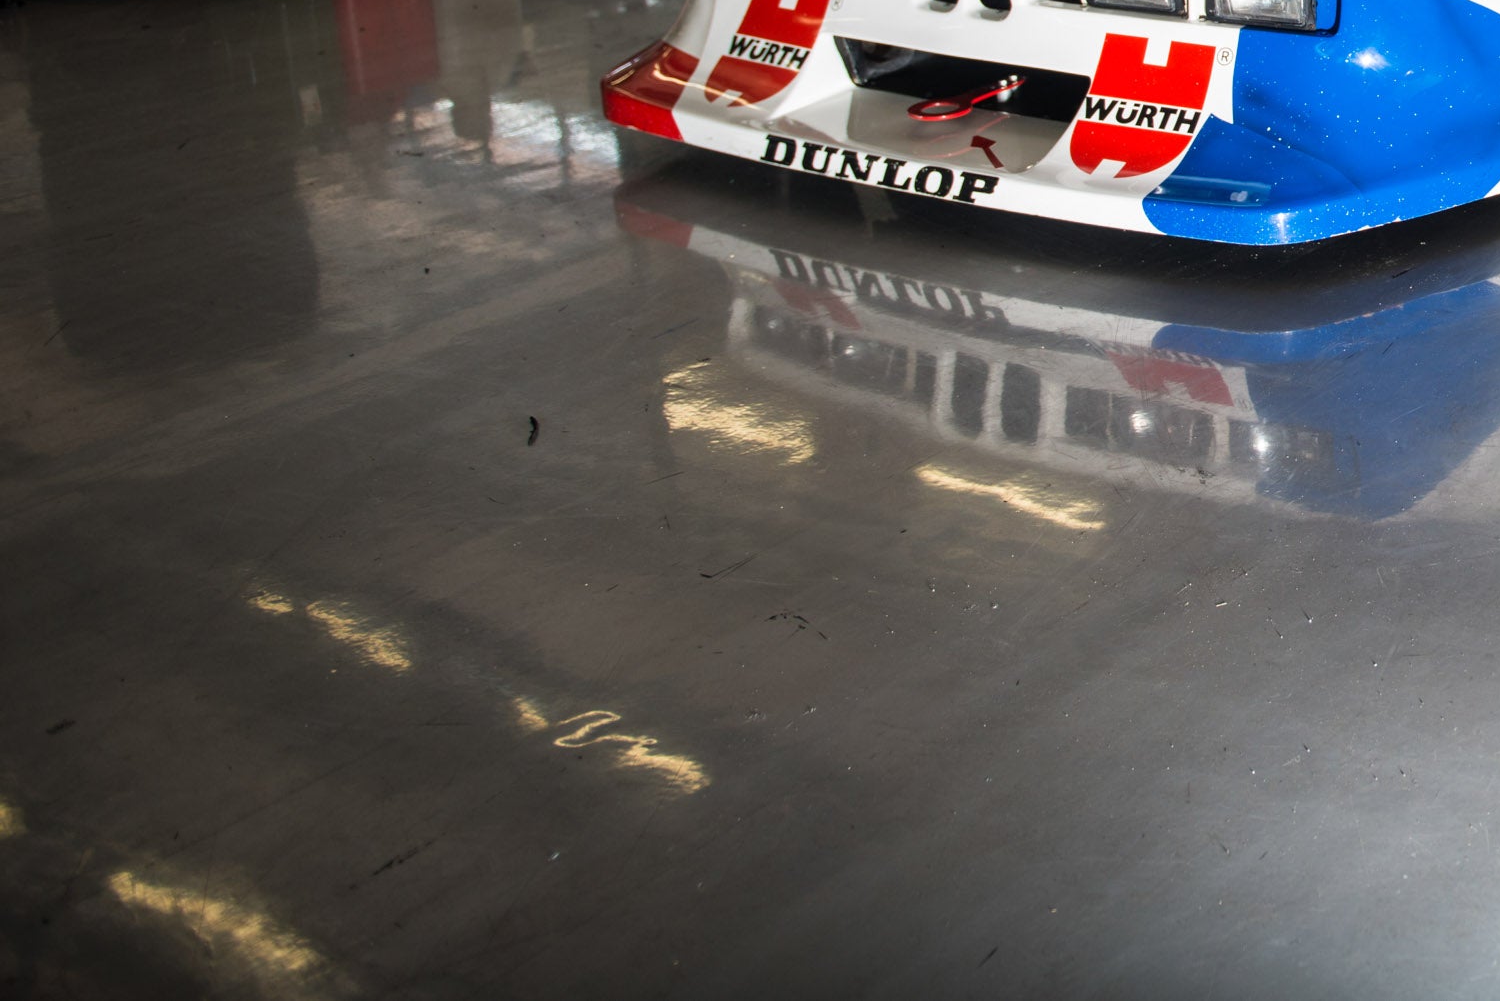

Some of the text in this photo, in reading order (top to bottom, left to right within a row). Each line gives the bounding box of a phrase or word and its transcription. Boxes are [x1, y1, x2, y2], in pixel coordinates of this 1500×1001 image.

[728, 34, 812, 70] WÜRTH
[1085, 96, 1202, 134] WÜRTH
[759, 133, 999, 204] DUNLOP
